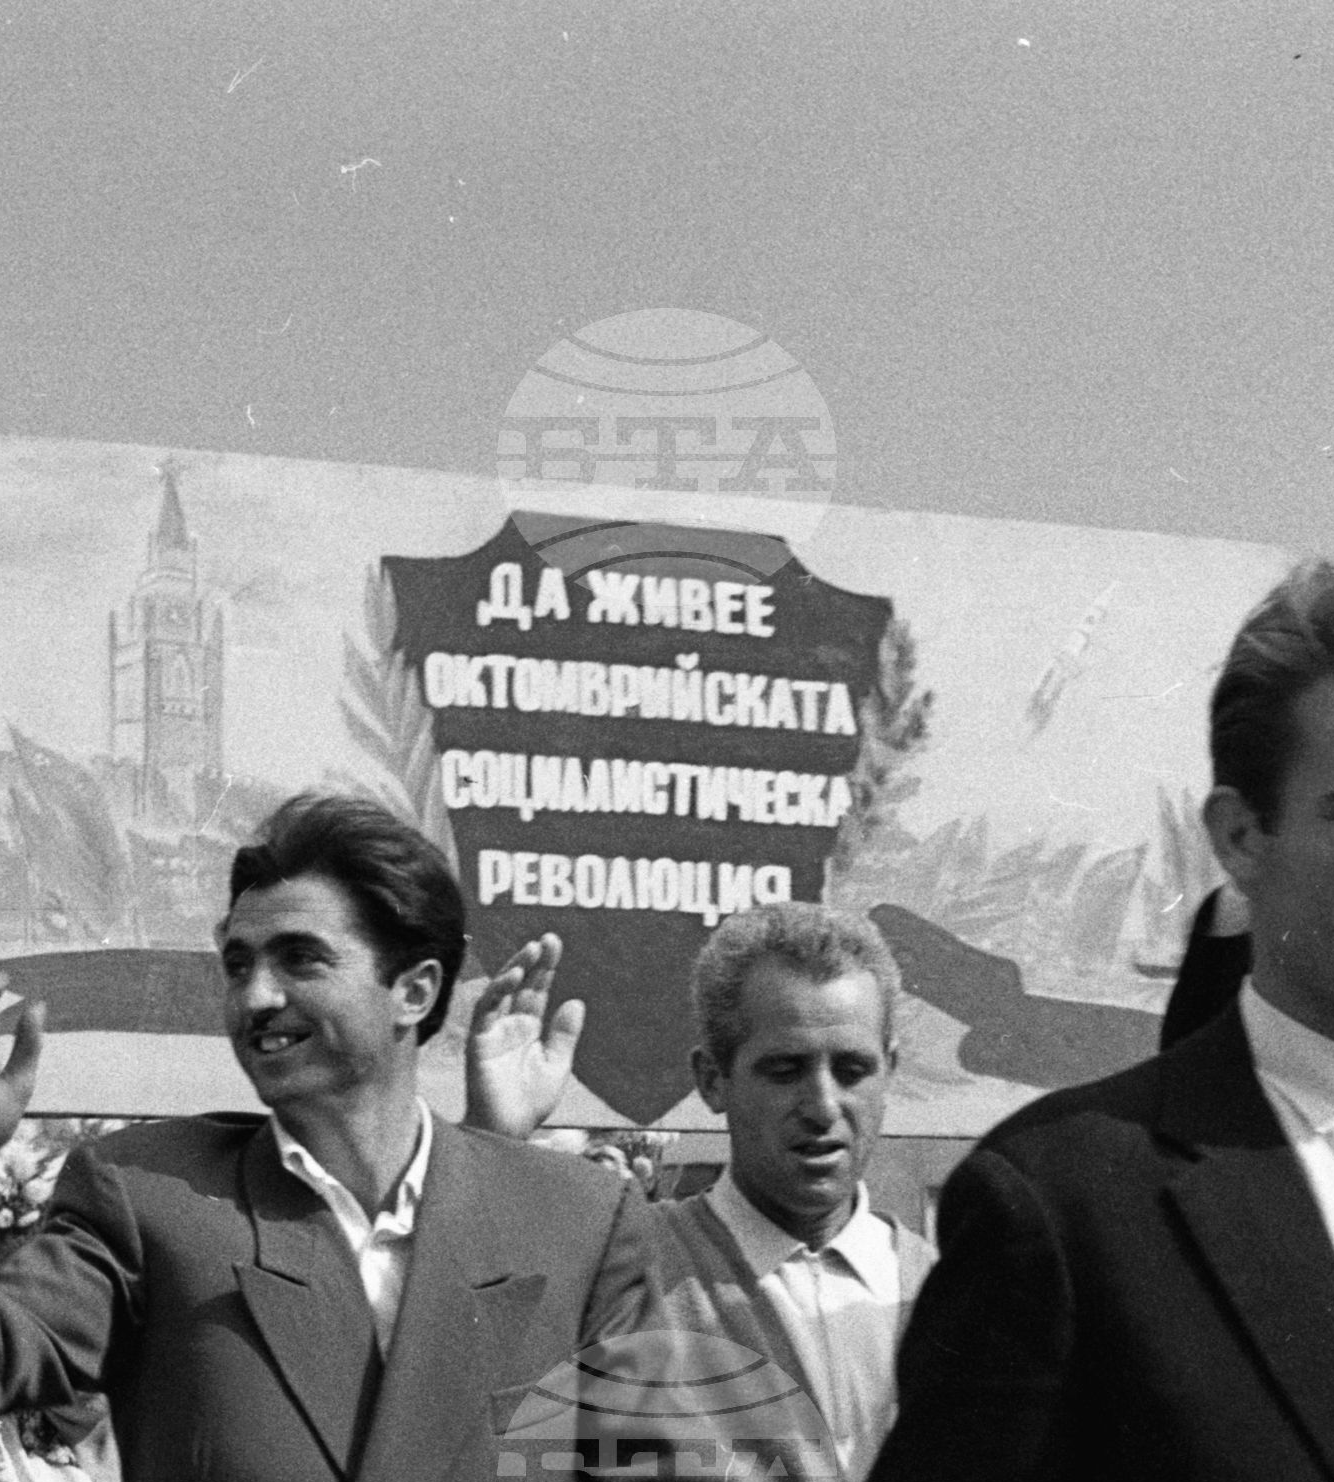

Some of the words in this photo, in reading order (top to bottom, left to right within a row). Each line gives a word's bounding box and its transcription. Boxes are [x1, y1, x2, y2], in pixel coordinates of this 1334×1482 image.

[477, 562, 570, 631] ДА
[586, 570, 776, 637] ЖИВЕЕ
[423, 652, 857, 735] ОКТОМВРИЙСКАТА
[440, 749, 853, 828] СОЦИАЛИСТИЧЕСКА
[478, 849, 793, 926] РЕВОЛЮЦИЯ
